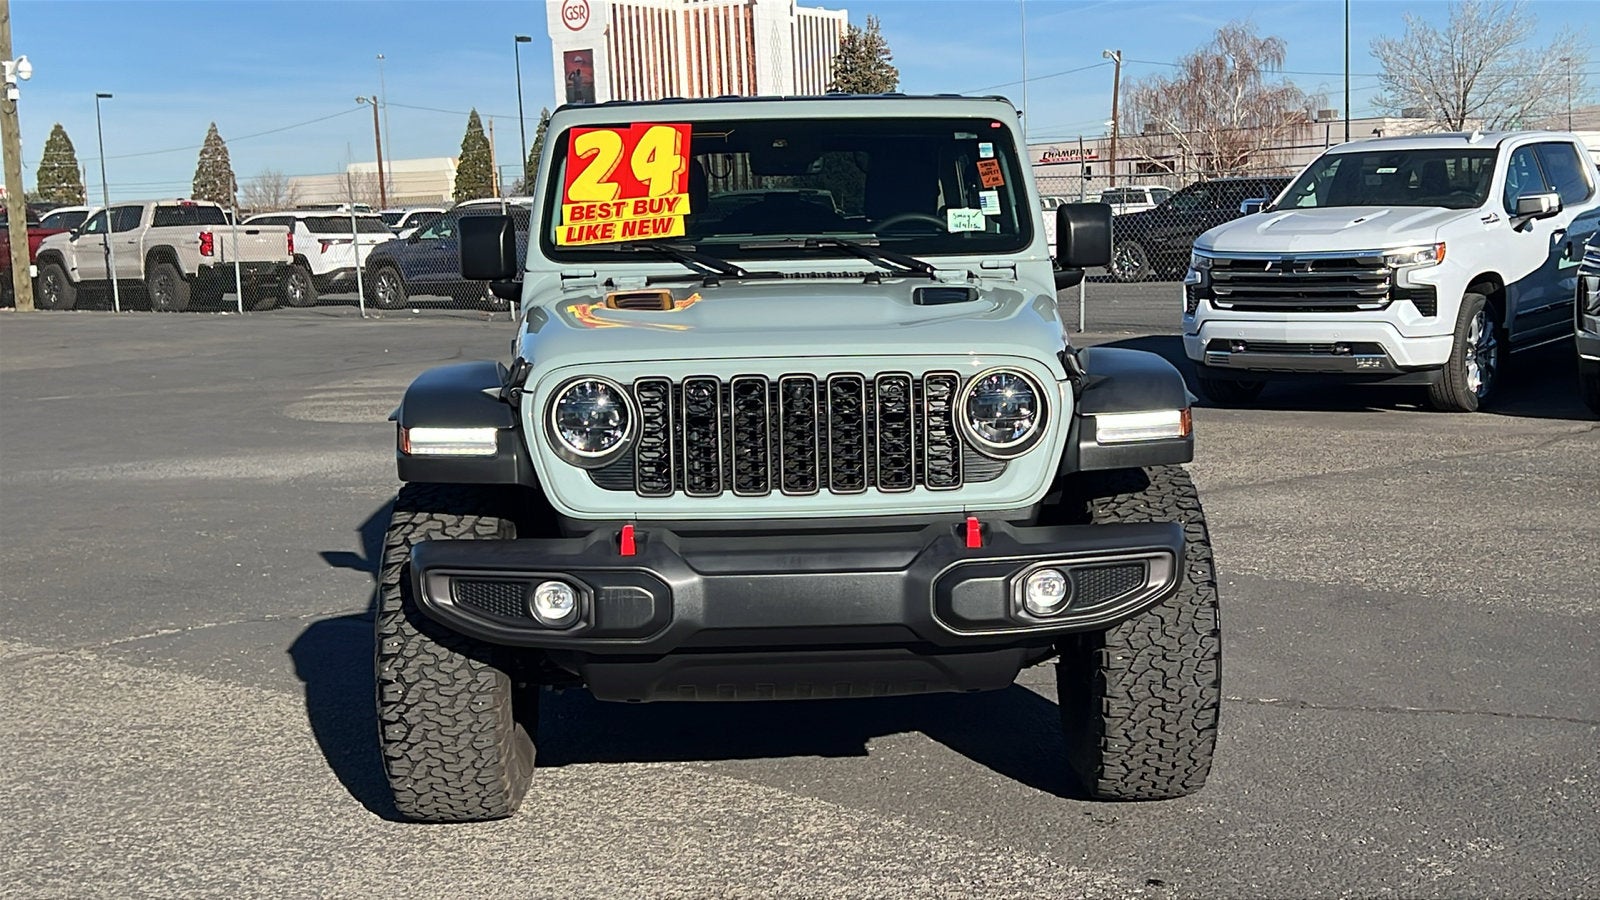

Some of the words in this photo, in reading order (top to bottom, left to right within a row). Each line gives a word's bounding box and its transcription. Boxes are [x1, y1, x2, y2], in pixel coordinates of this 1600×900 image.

[565, 5, 586, 20] GSR
[568, 126, 686, 202] 24
[569, 202, 628, 222] BEST
[633, 197, 681, 215] BUY
[565, 223, 616, 242] LIKE
[621, 217, 675, 237] NEW
